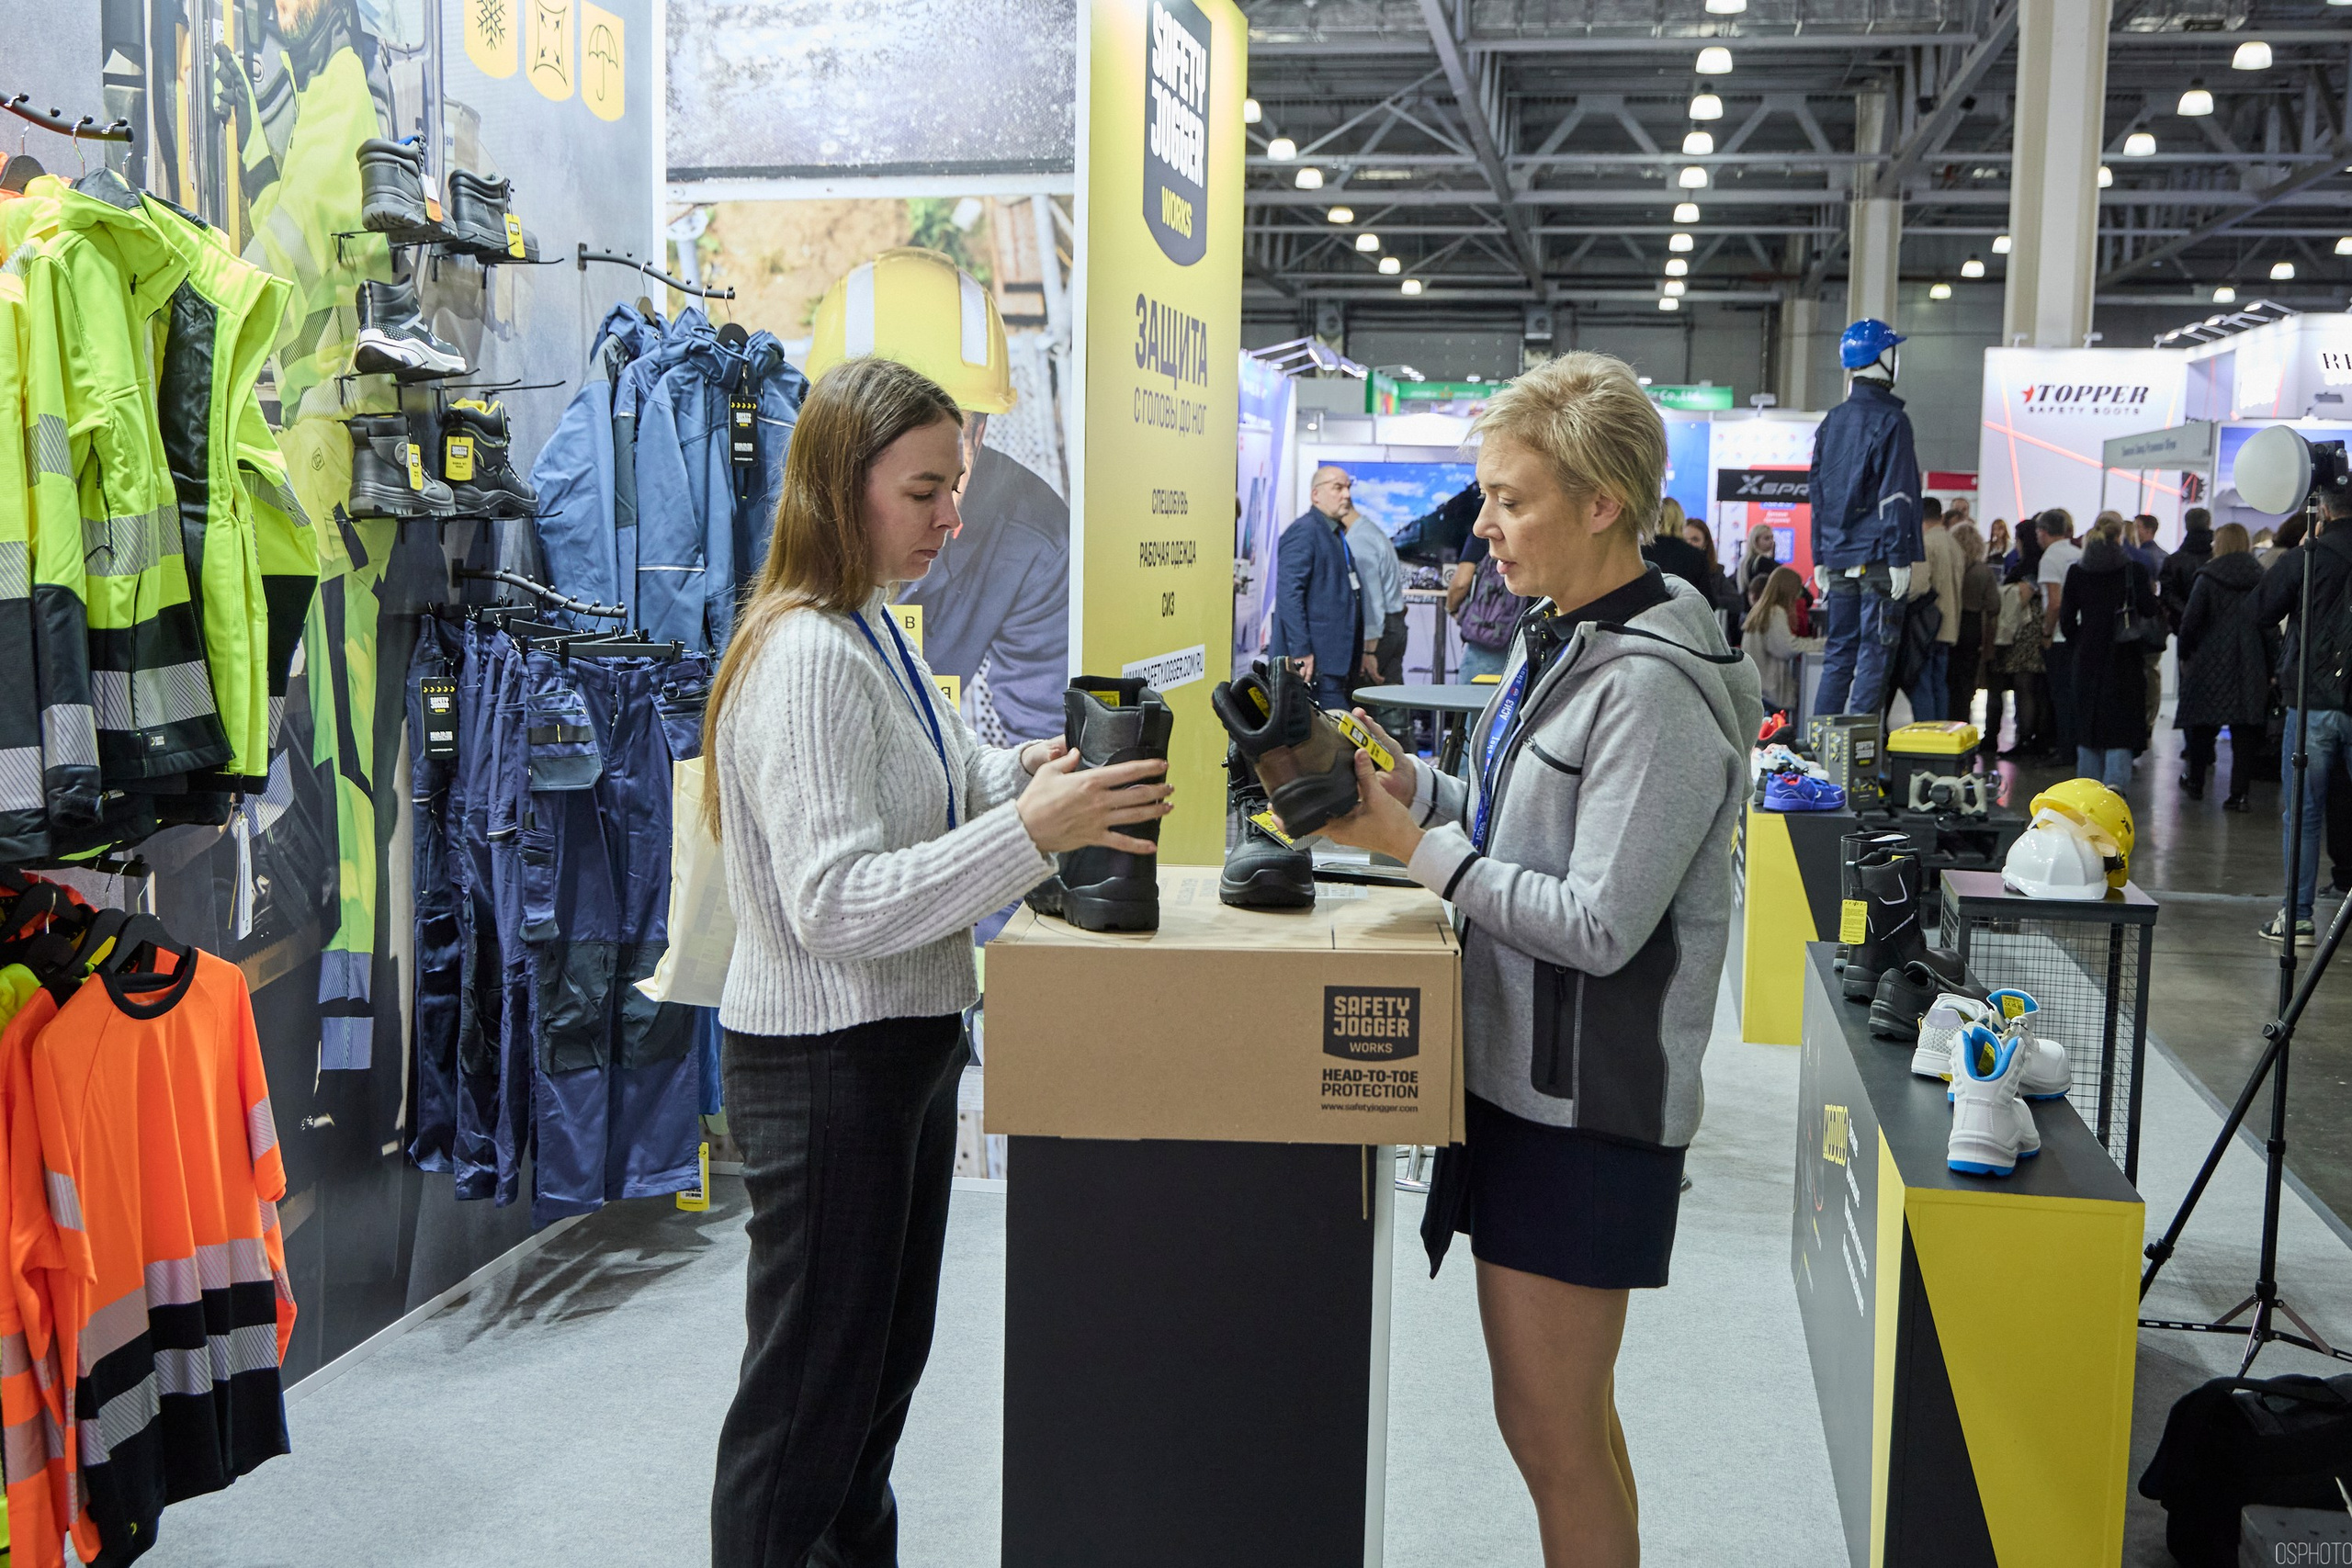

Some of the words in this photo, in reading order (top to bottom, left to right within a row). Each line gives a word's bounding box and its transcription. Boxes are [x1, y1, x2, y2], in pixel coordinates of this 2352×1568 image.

[1151, 0, 1206, 114] SAFETY
[1150, 78, 1205, 188] JOGGER
[1161, 186, 1193, 239] WORKS
[1135, 292, 1207, 391] ЗАЩИТА
[2038, 385, 2149, 403] TOPPER
[1142, 389, 1178, 431] ГОЛОВЫ
[1178, 398, 1192, 437] ДО
[1192, 401, 1207, 436] НОГ
[2029, 406, 2086, 414] SAFETY
[1152, 488, 1188, 519] СПЕЦОБУВЬ
[1139, 541, 1170, 568] РАБОЧАЯ
[1170, 540, 1196, 570] ОДЕЖДА
[1161, 591, 1175, 618] СИЗ
[1499, 698, 1515, 721] АСИЗ
[1334, 996, 1410, 1017] SAFETY
[1333, 1016, 1409, 1038] JOGGER
[1350, 1042, 1393, 1054] WORKS
[1322, 1068, 1419, 1083] HEAD-TO-TOE
[1321, 1083, 1419, 1099] PROTECTION
[1321, 1102, 1419, 1113] www.safetyjogger.com
